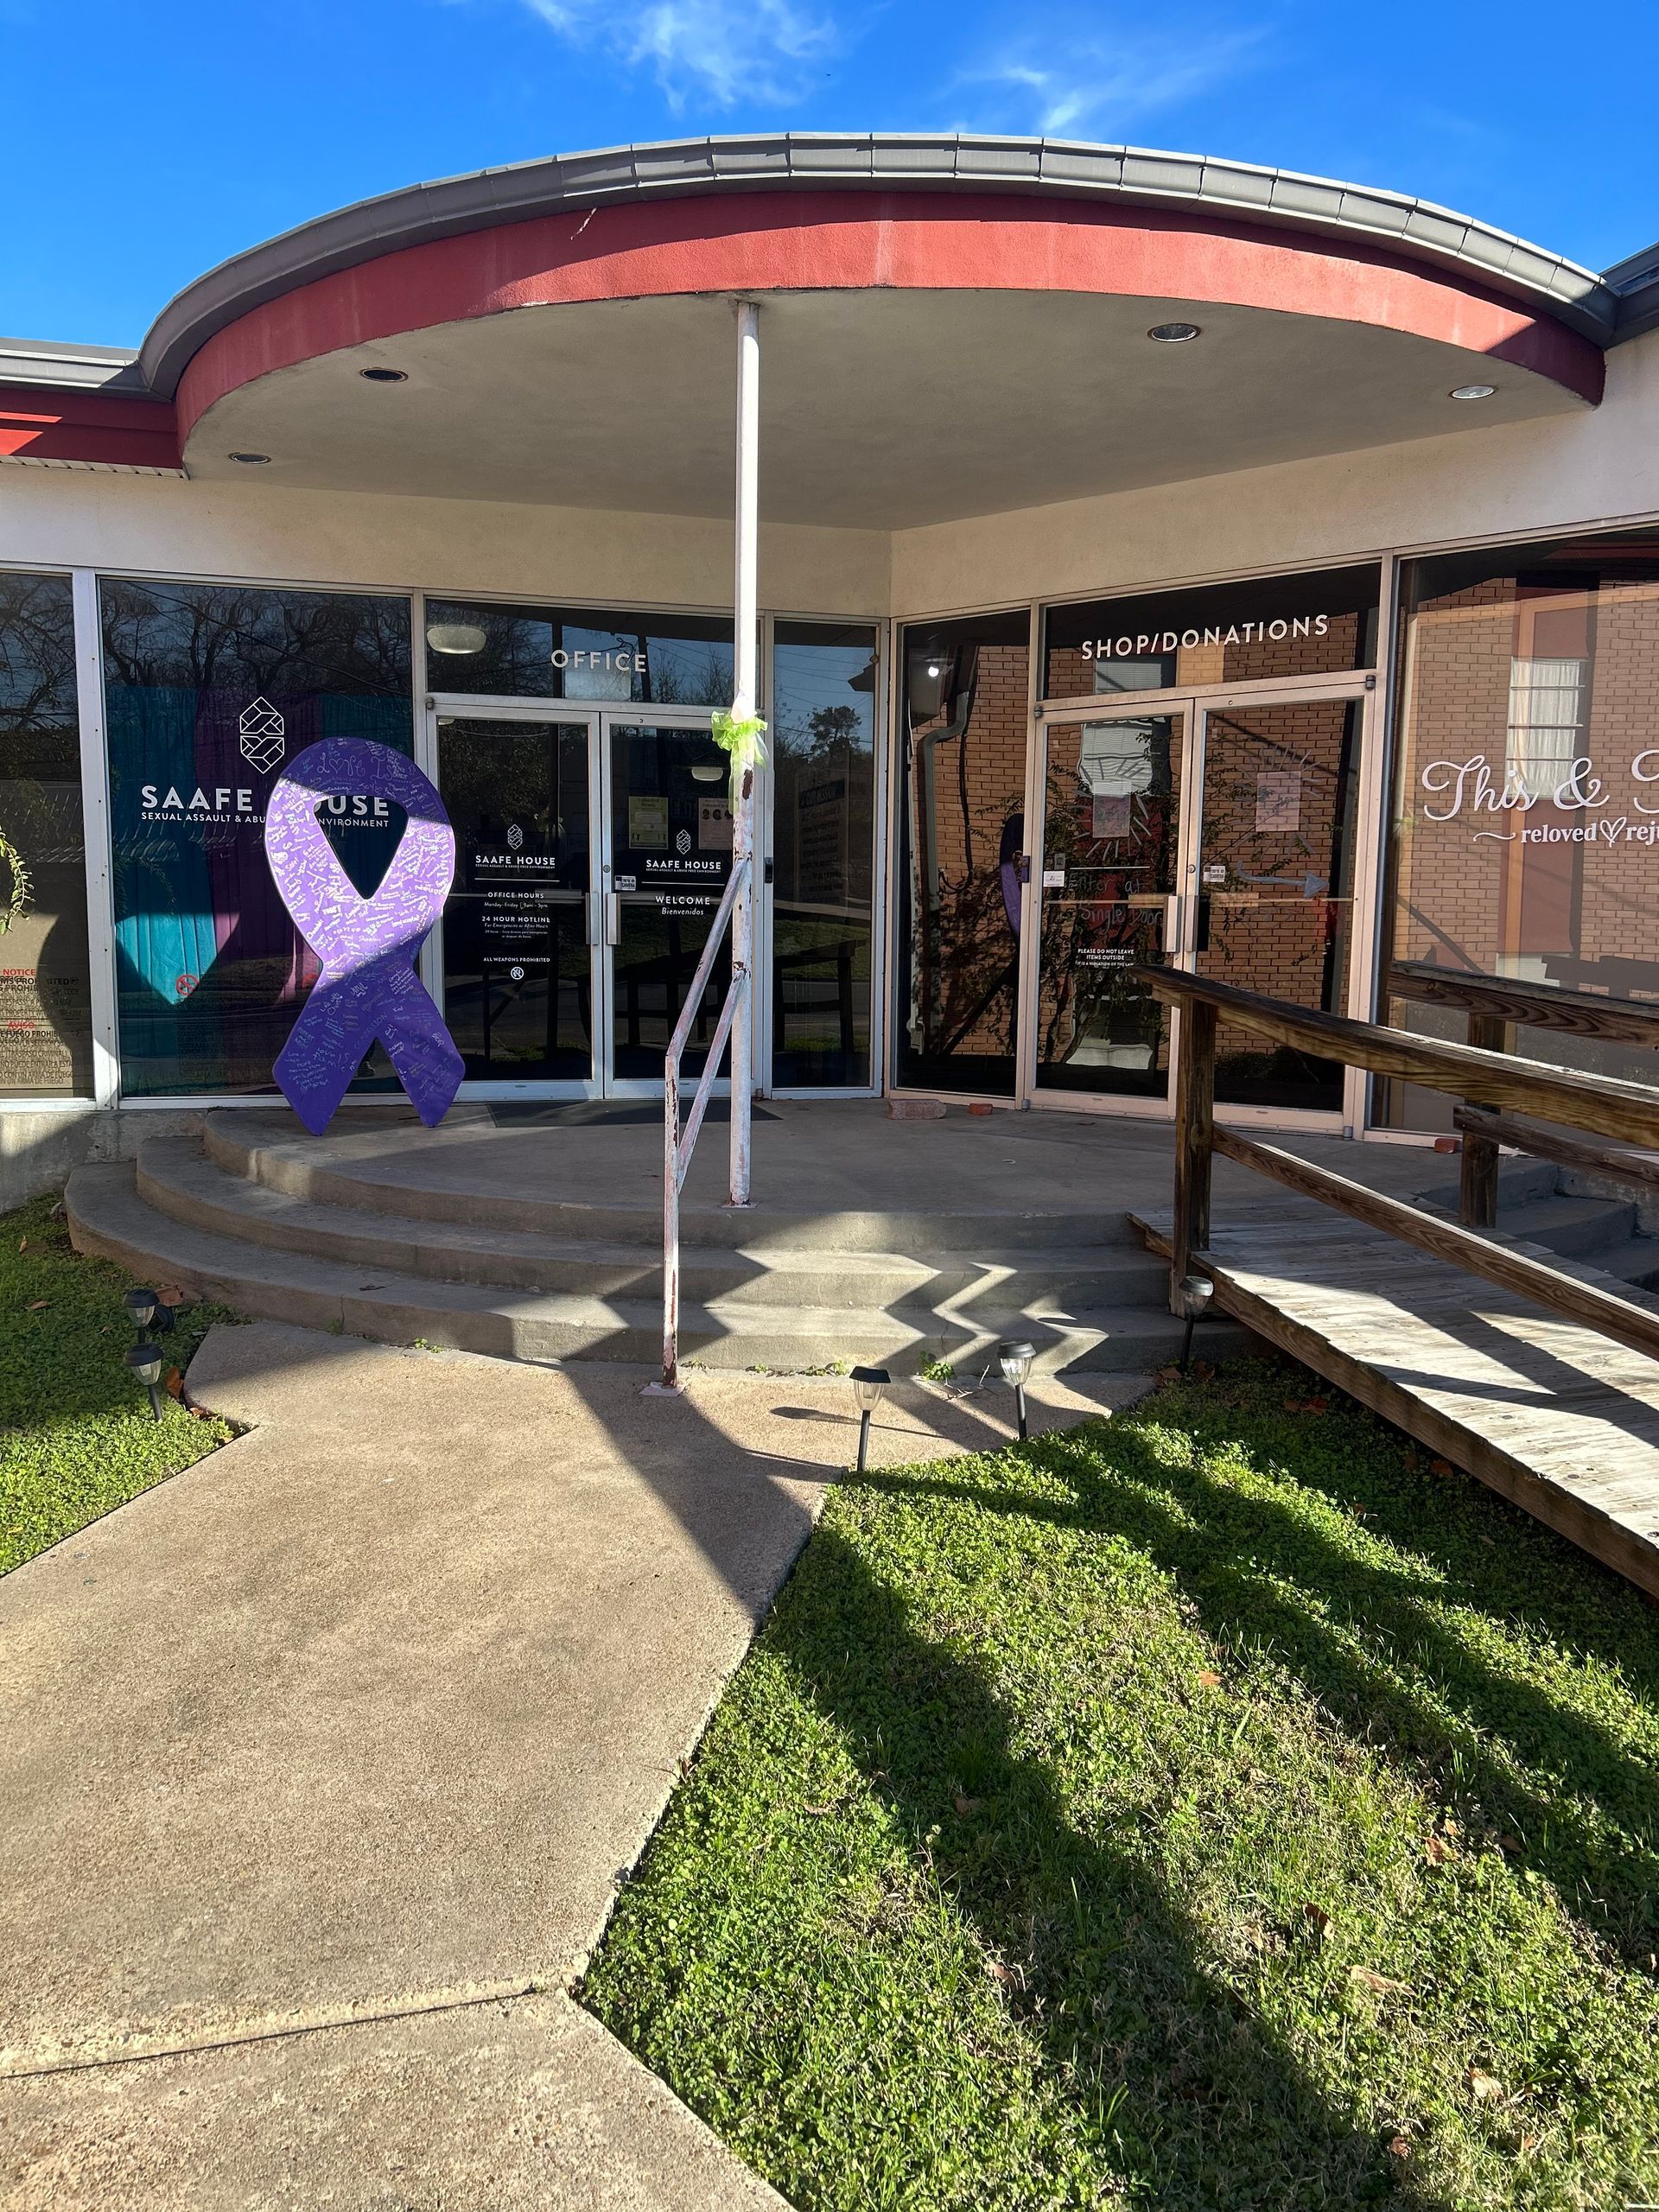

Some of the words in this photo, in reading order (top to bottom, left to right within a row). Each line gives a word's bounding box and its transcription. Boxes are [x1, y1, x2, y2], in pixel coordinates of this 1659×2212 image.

[1081, 614, 1328, 660] SHOP/DONATIONS
[551, 649, 646, 672] OFFICE
[1422, 754, 1540, 821] This
[1554, 758, 1610, 810] &
[142, 785, 253, 811] SAAFE
[315, 795, 389, 816] USE
[142, 811, 182, 821] SEXUAL
[186, 813, 231, 823] ASSAULT
[318, 817, 389, 828] NVIRONMENT
[1521, 823, 1597, 842] reloved
[475, 855, 512, 864] SAAFE
[517, 856, 556, 866] HOUSE
[645, 860, 680, 868] SAAFE
[685, 861, 721, 870] HOUSE
[656, 896, 710, 905] WELCOME
